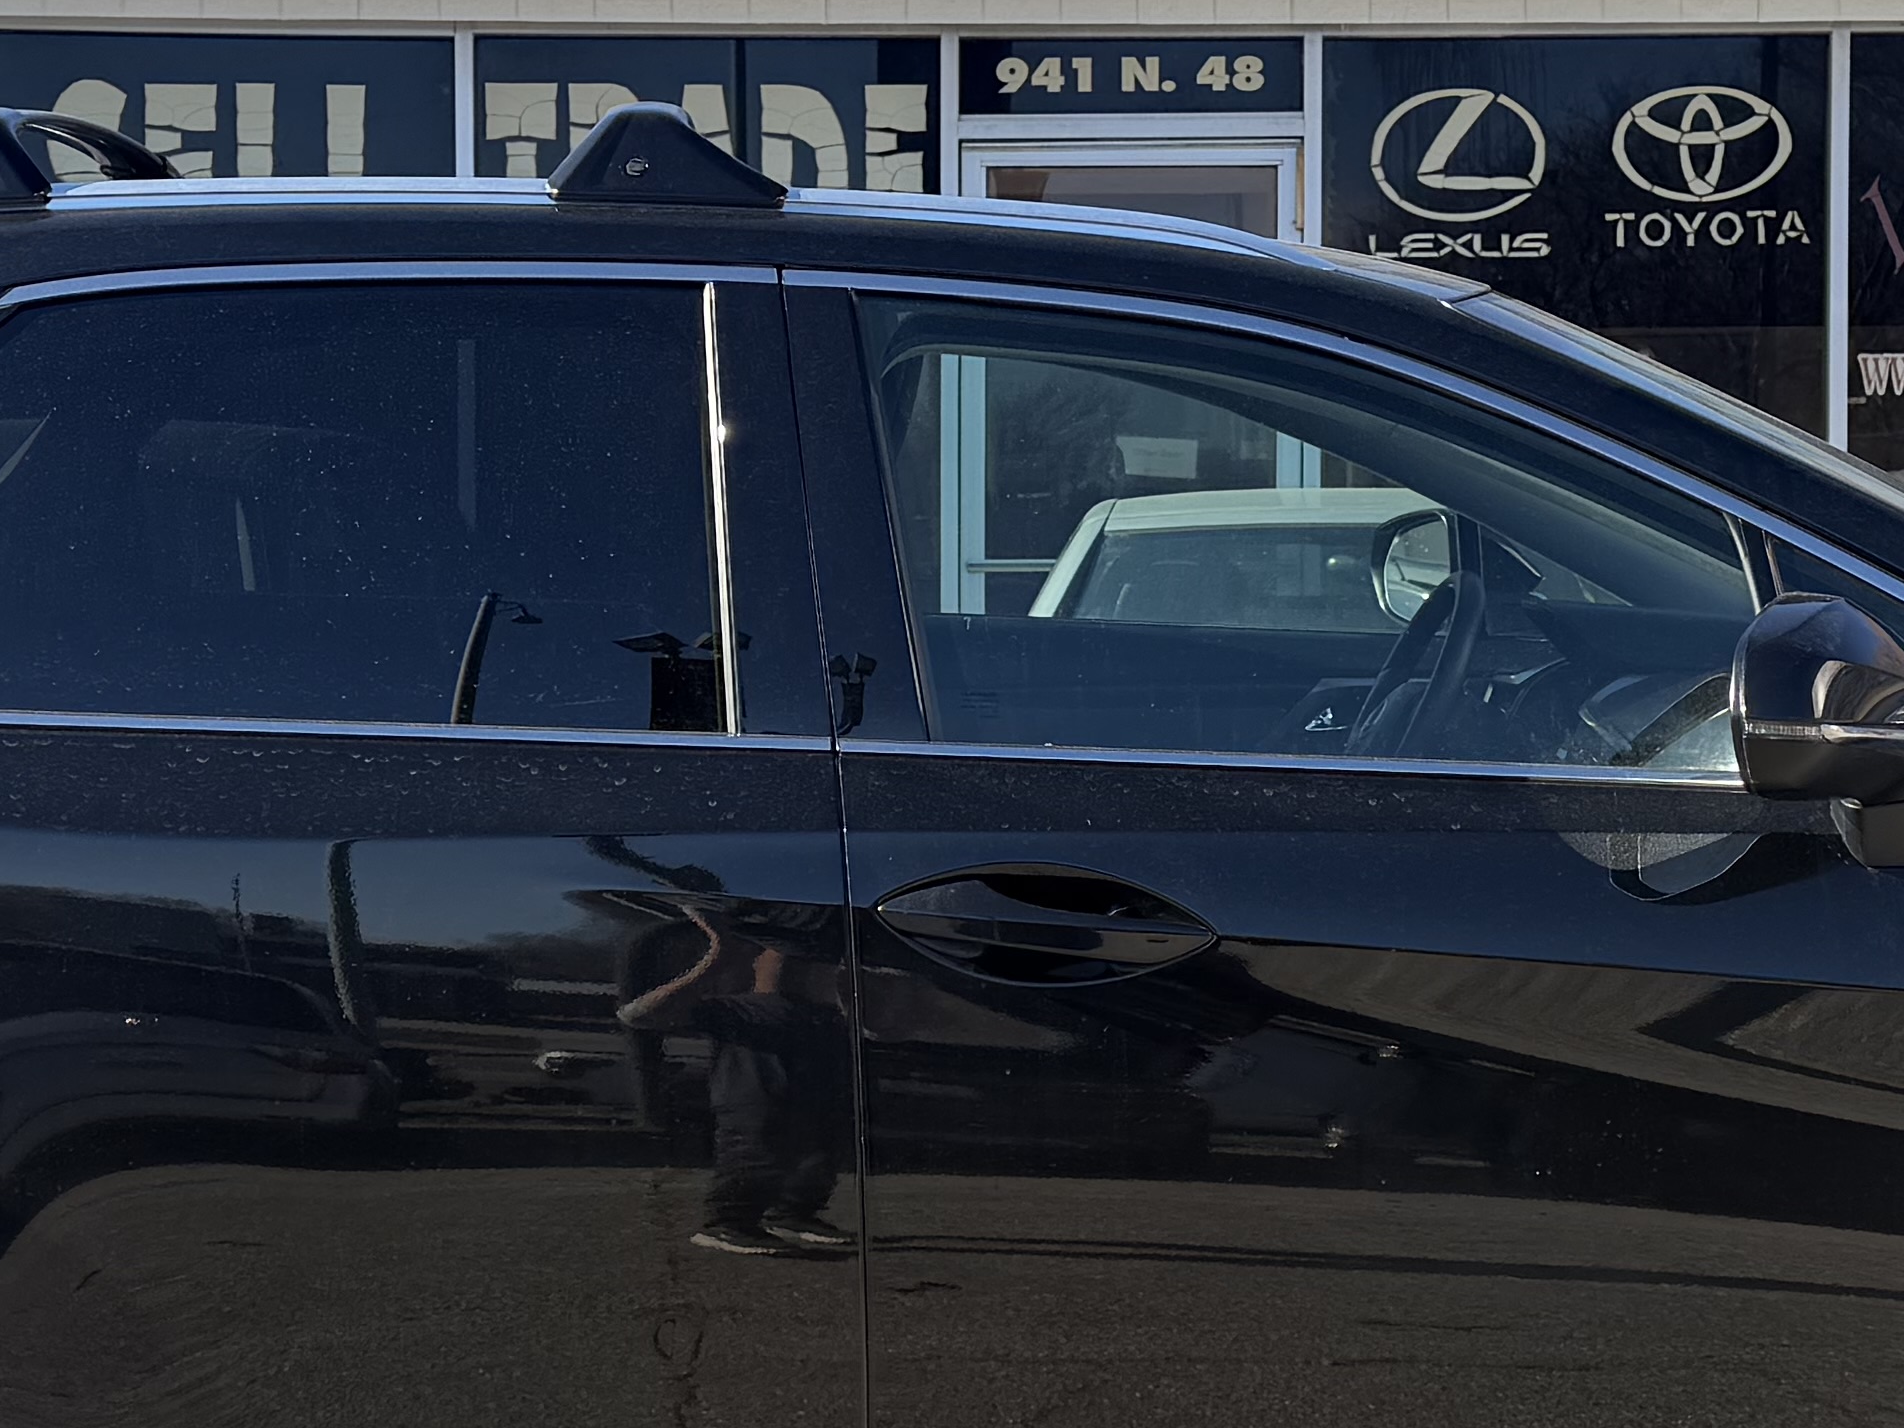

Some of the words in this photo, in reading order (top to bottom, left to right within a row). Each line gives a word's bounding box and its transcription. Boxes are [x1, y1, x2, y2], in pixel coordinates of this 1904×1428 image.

[995, 56, 1093, 94] 941
[1120, 55, 1177, 93] N.
[1195, 55, 1266, 92] 48
[1367, 231, 1552, 260] LEXUS
[1604, 208, 1812, 249] TOYOTA
